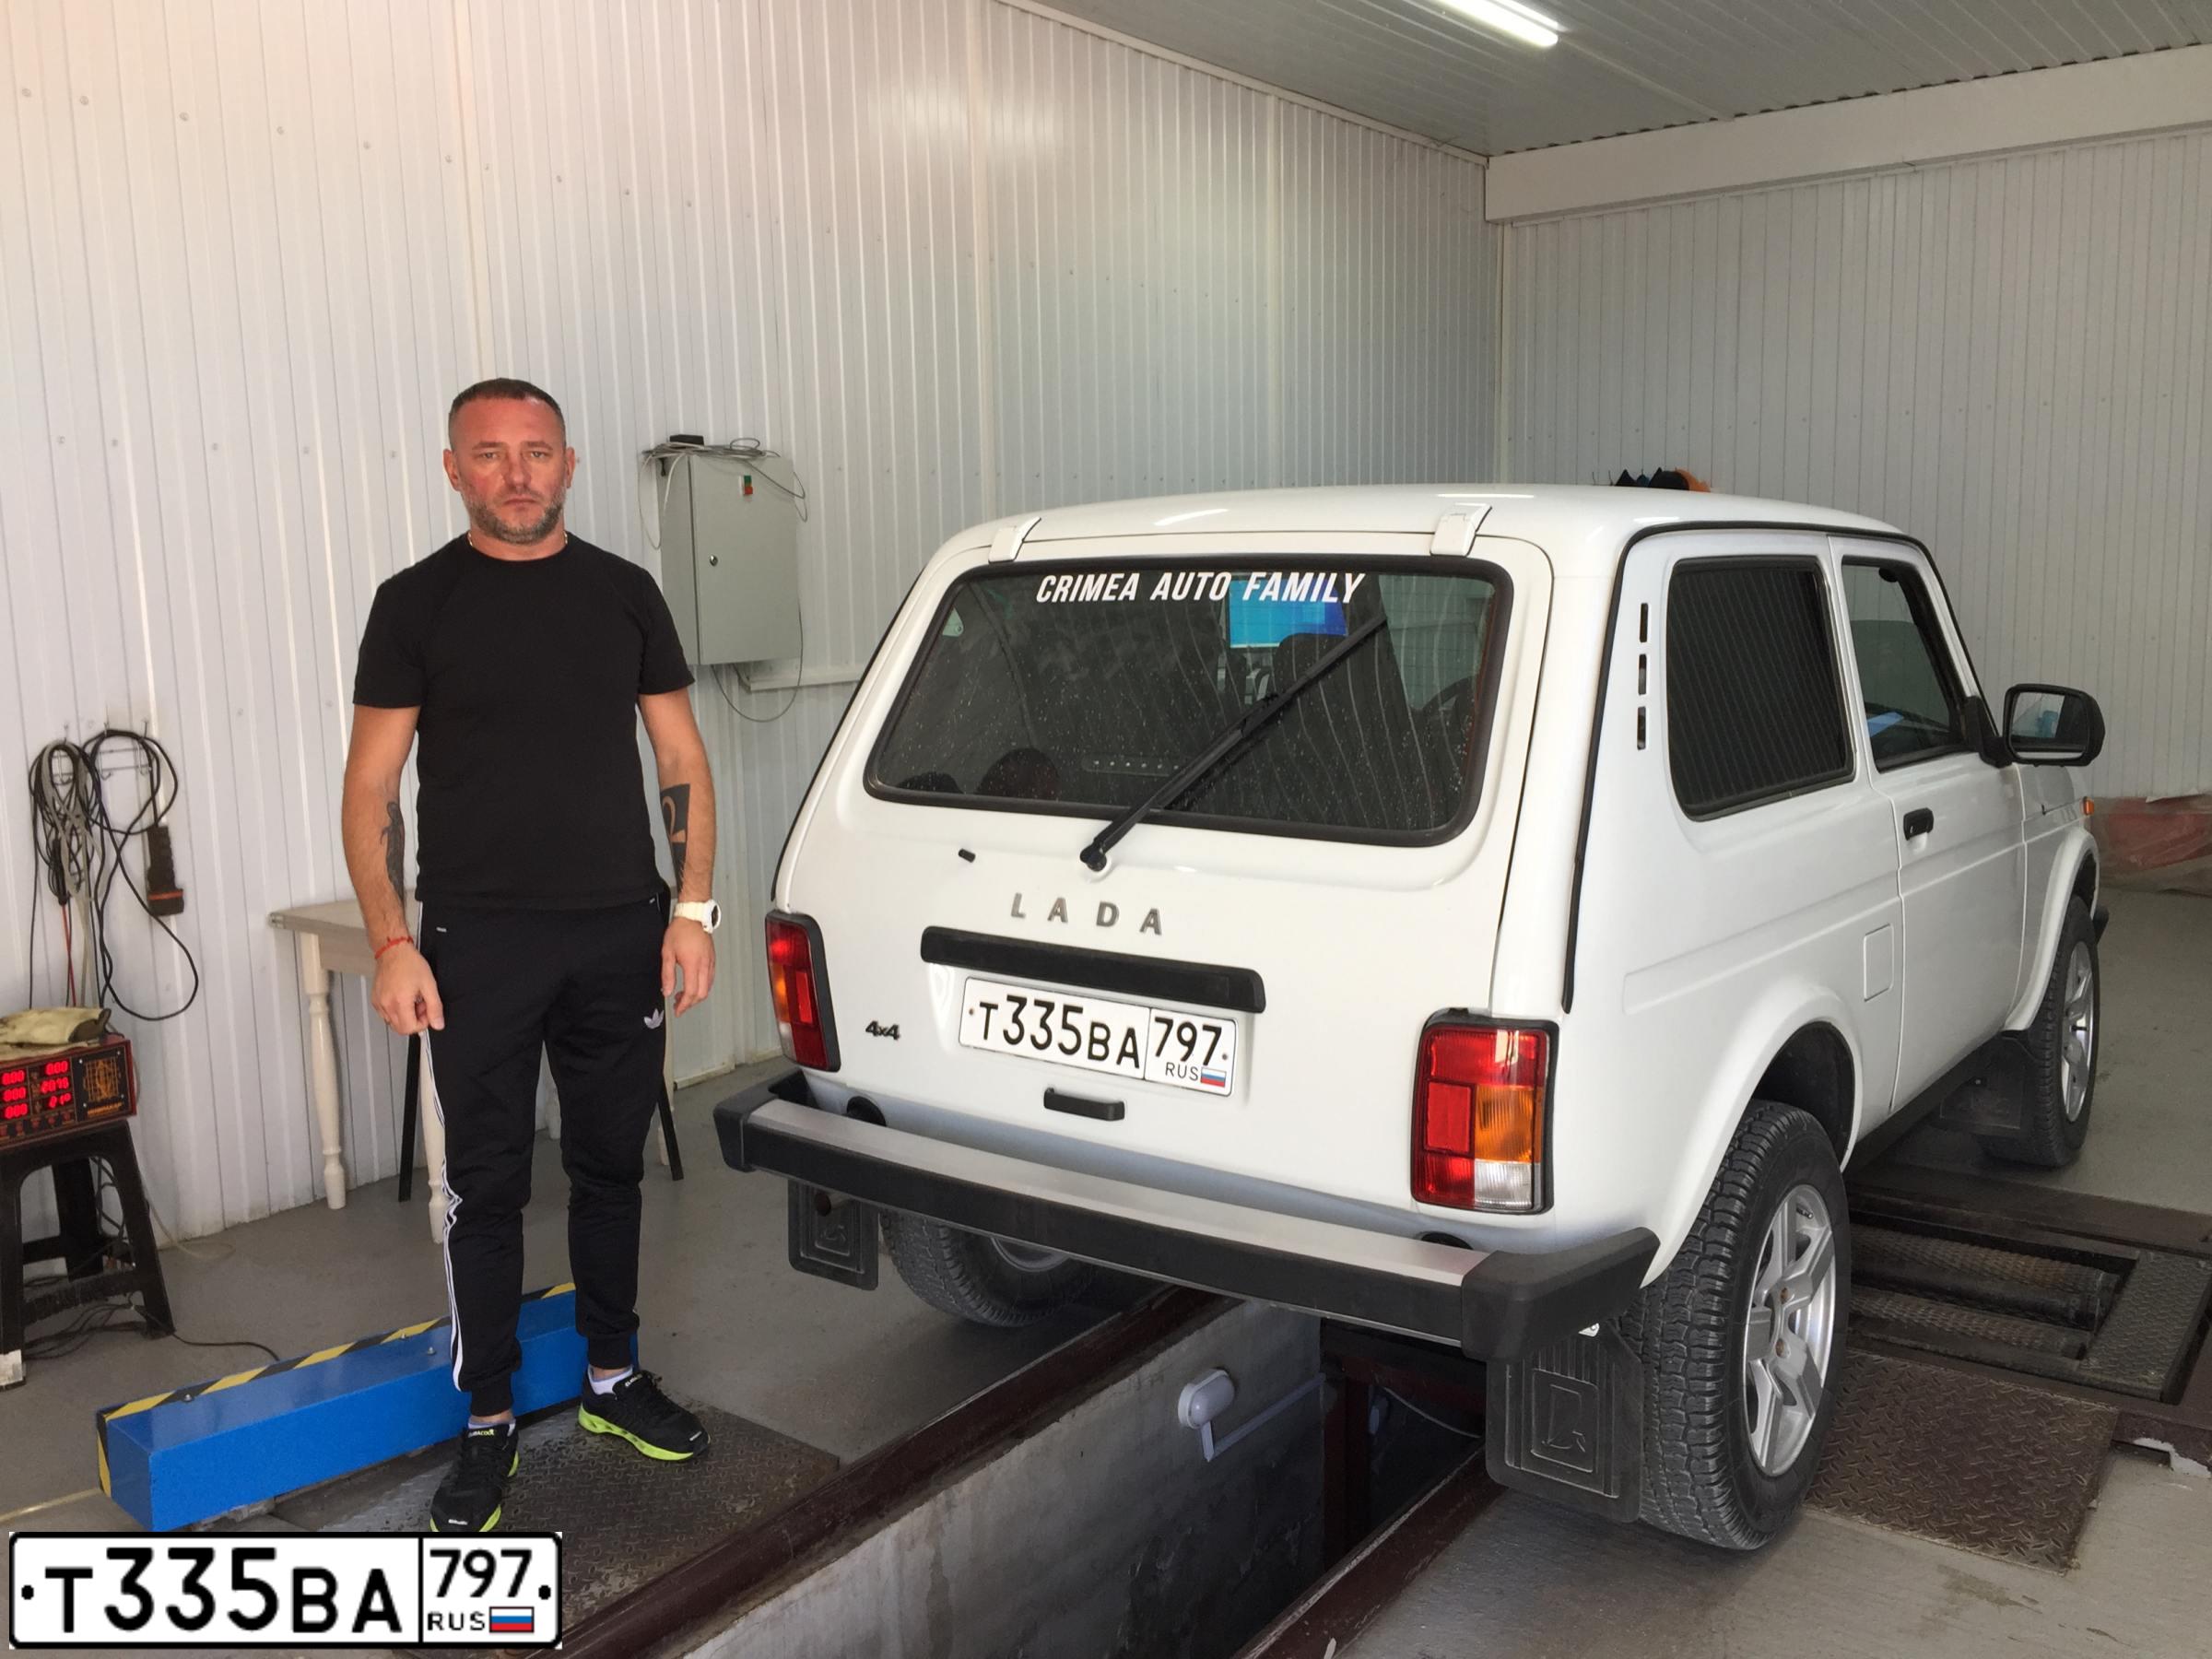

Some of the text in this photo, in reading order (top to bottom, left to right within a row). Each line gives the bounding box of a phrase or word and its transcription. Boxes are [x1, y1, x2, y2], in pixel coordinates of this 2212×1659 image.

[1036, 571, 1365, 604] CRIMEA AUTO FAMILY
[1010, 893, 1162, 936] LADA
[1154, 1017, 1223, 1066] 797
[1165, 1061, 1198, 1082] RUS
